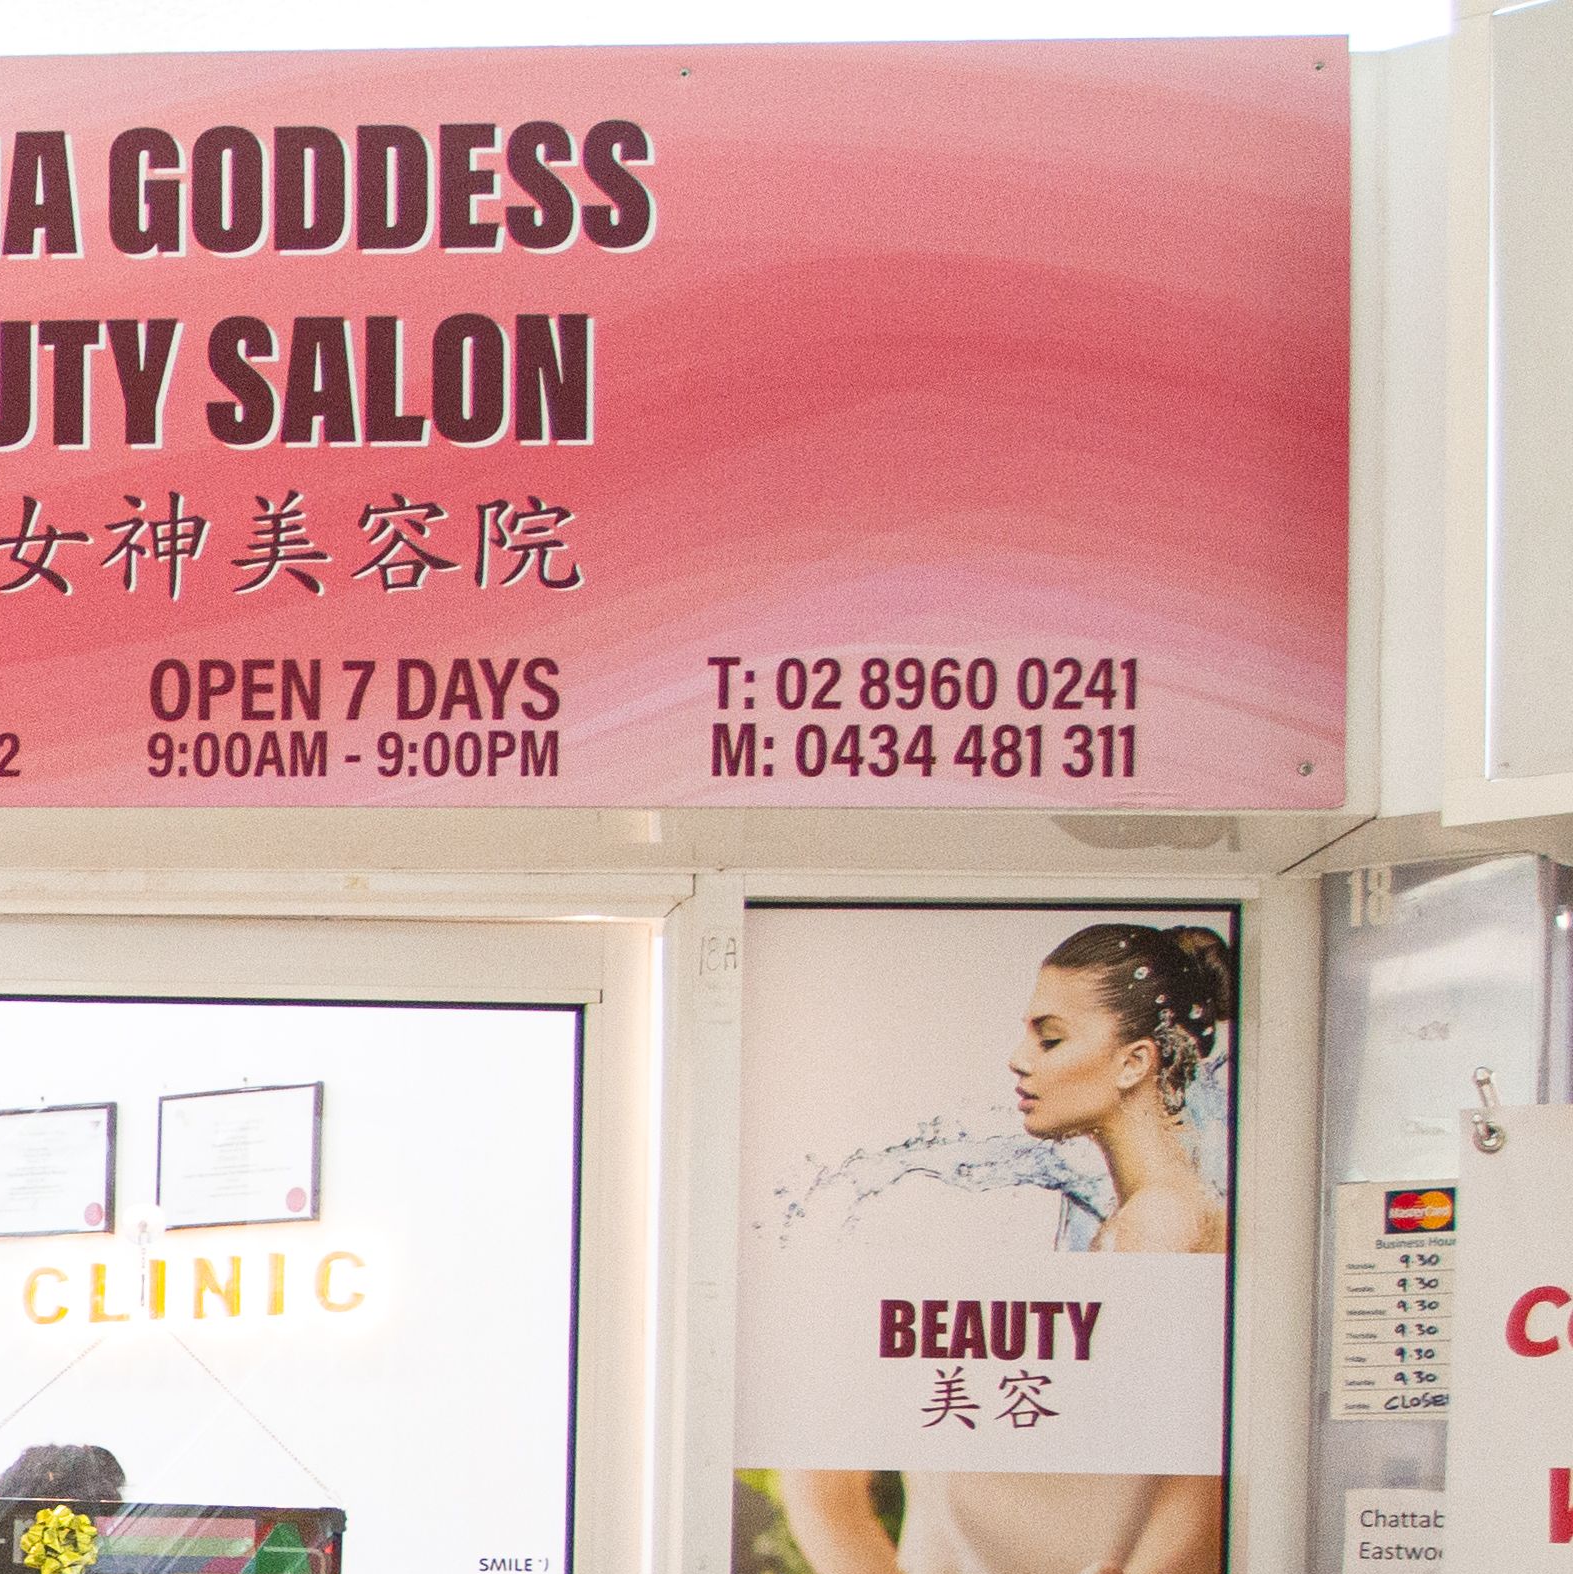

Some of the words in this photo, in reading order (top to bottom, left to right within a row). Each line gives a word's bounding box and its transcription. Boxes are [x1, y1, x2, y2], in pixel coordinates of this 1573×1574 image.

[108, 119, 655, 258] GODDESS
[206, 312, 595, 450] SALON
[150, 657, 322, 720] OPEN
[342, 658, 378, 720] 7
[398, 656, 561, 720] DAYS
[707, 657, 757, 711] T:
[775, 656, 841, 711] 02
[859, 656, 997, 711] 8960
[1016, 656, 1139, 711] 0241
[147, 731, 328, 778] 9:00AM
[378, 731, 560, 777] 9:00PM
[711, 724, 775, 778] M:
[793, 724, 938, 778] 0434
[953, 724, 1044, 778] 481
[1062, 723, 1138, 777] 311
[1376, 1238, 1425, 1249] Business
[23, 1251, 368, 1327] CLINIC
[880, 1298, 1103, 1362] BEAUTY
[920, 1367, 1061, 1430] 美容
[479, 1558, 533, 1572] SMILE
